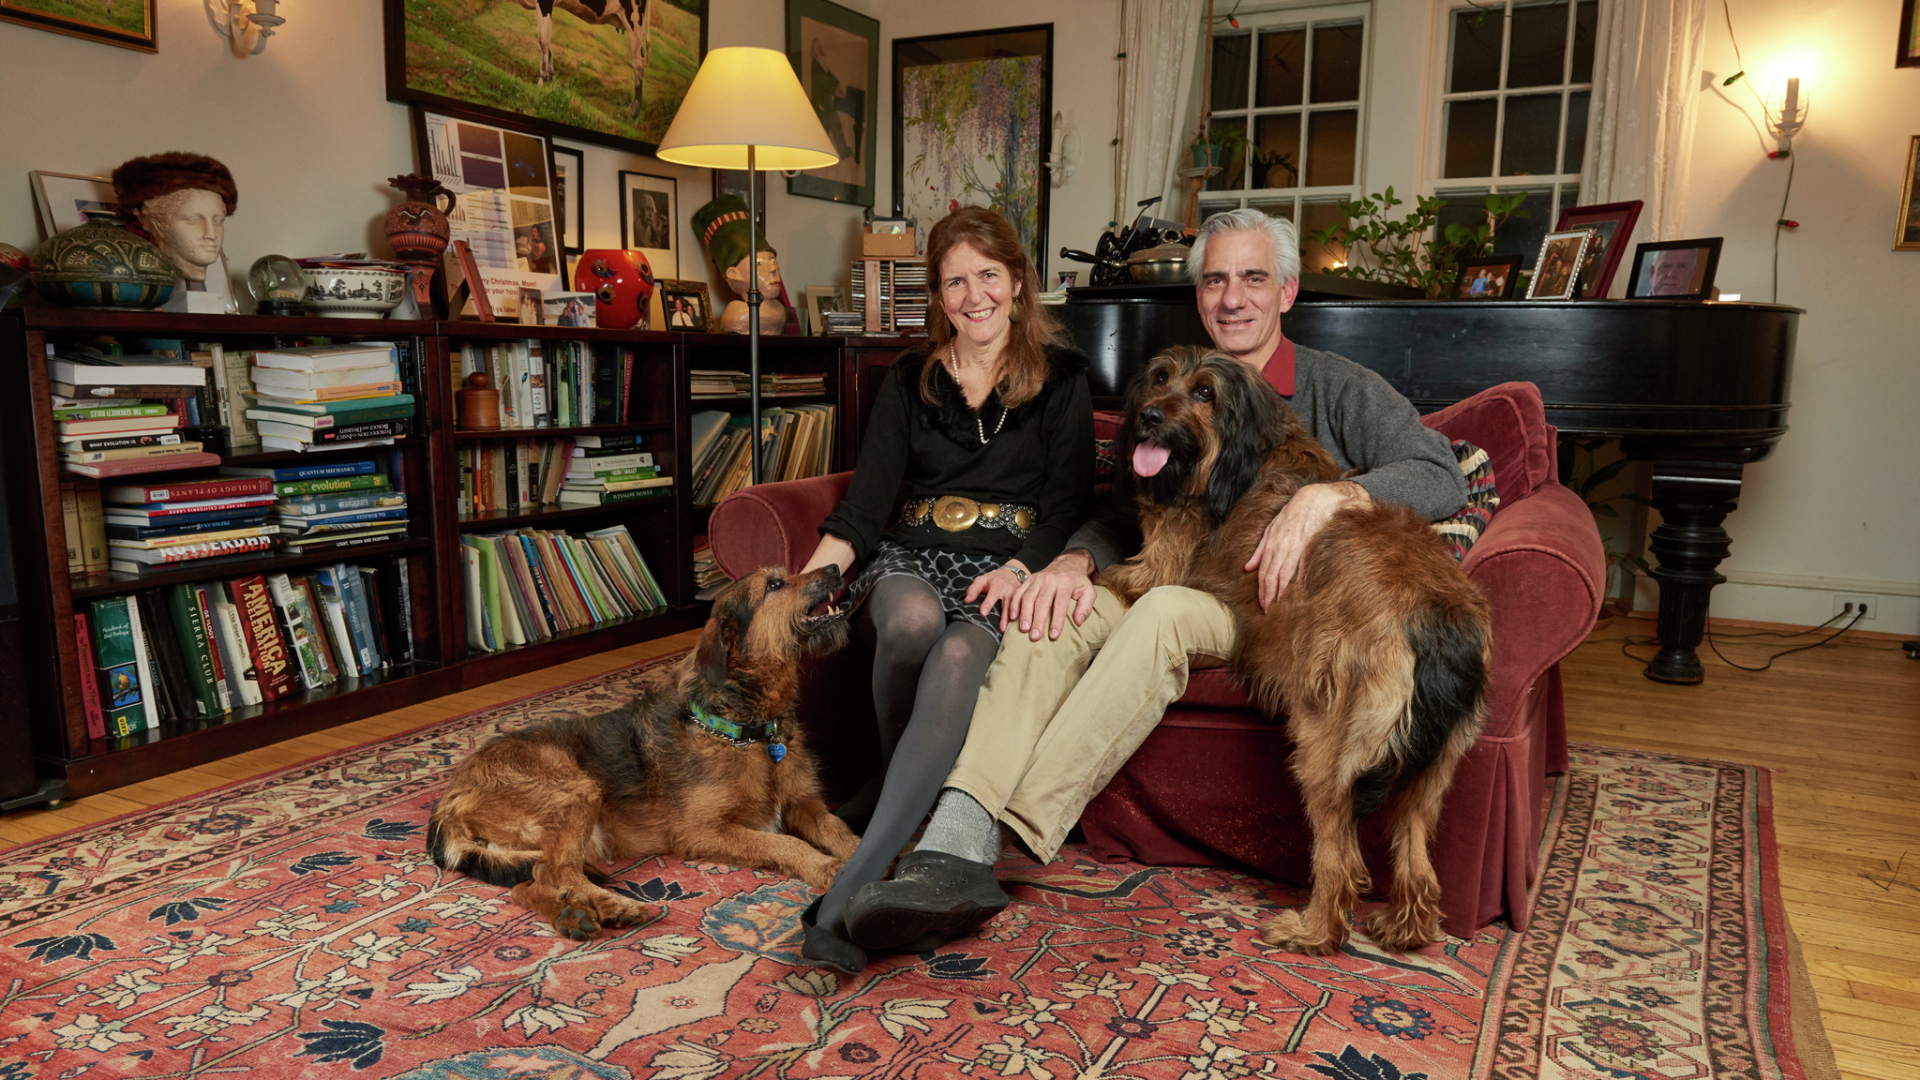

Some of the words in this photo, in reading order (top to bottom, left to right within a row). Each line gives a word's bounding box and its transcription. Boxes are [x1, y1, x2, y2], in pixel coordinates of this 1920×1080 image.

[490, 278, 520, 286] Christmas,
[90, 410, 106, 418] RULES
[107, 409, 132, 417] SERENGETI
[298, 468, 325, 477] QUANTUM
[325, 466, 355, 474] MECHANICS
[223, 484, 257, 494] BIOLOGY
[311, 479, 351, 491] evolution
[170, 488, 206, 496] PLANTS
[613, 492, 635, 500] WINSLOW
[187, 505, 216, 513] CALIFORNIA
[159, 536, 271, 557] ROTTERDAM
[243, 593, 251, 601] A
[102, 624, 122, 633] Handbook
[203, 609, 215, 639] GEOLOGY
[248, 583, 286, 676] AMERICA
[246, 601, 272, 674] CELEBRATION!
[188, 606, 205, 649] SIERRA
[201, 654, 214, 684] CLUB
[237, 635, 246, 658] Pianists
[149, 660, 160, 687] ZOOLOGY
[119, 718, 127, 734] USED
